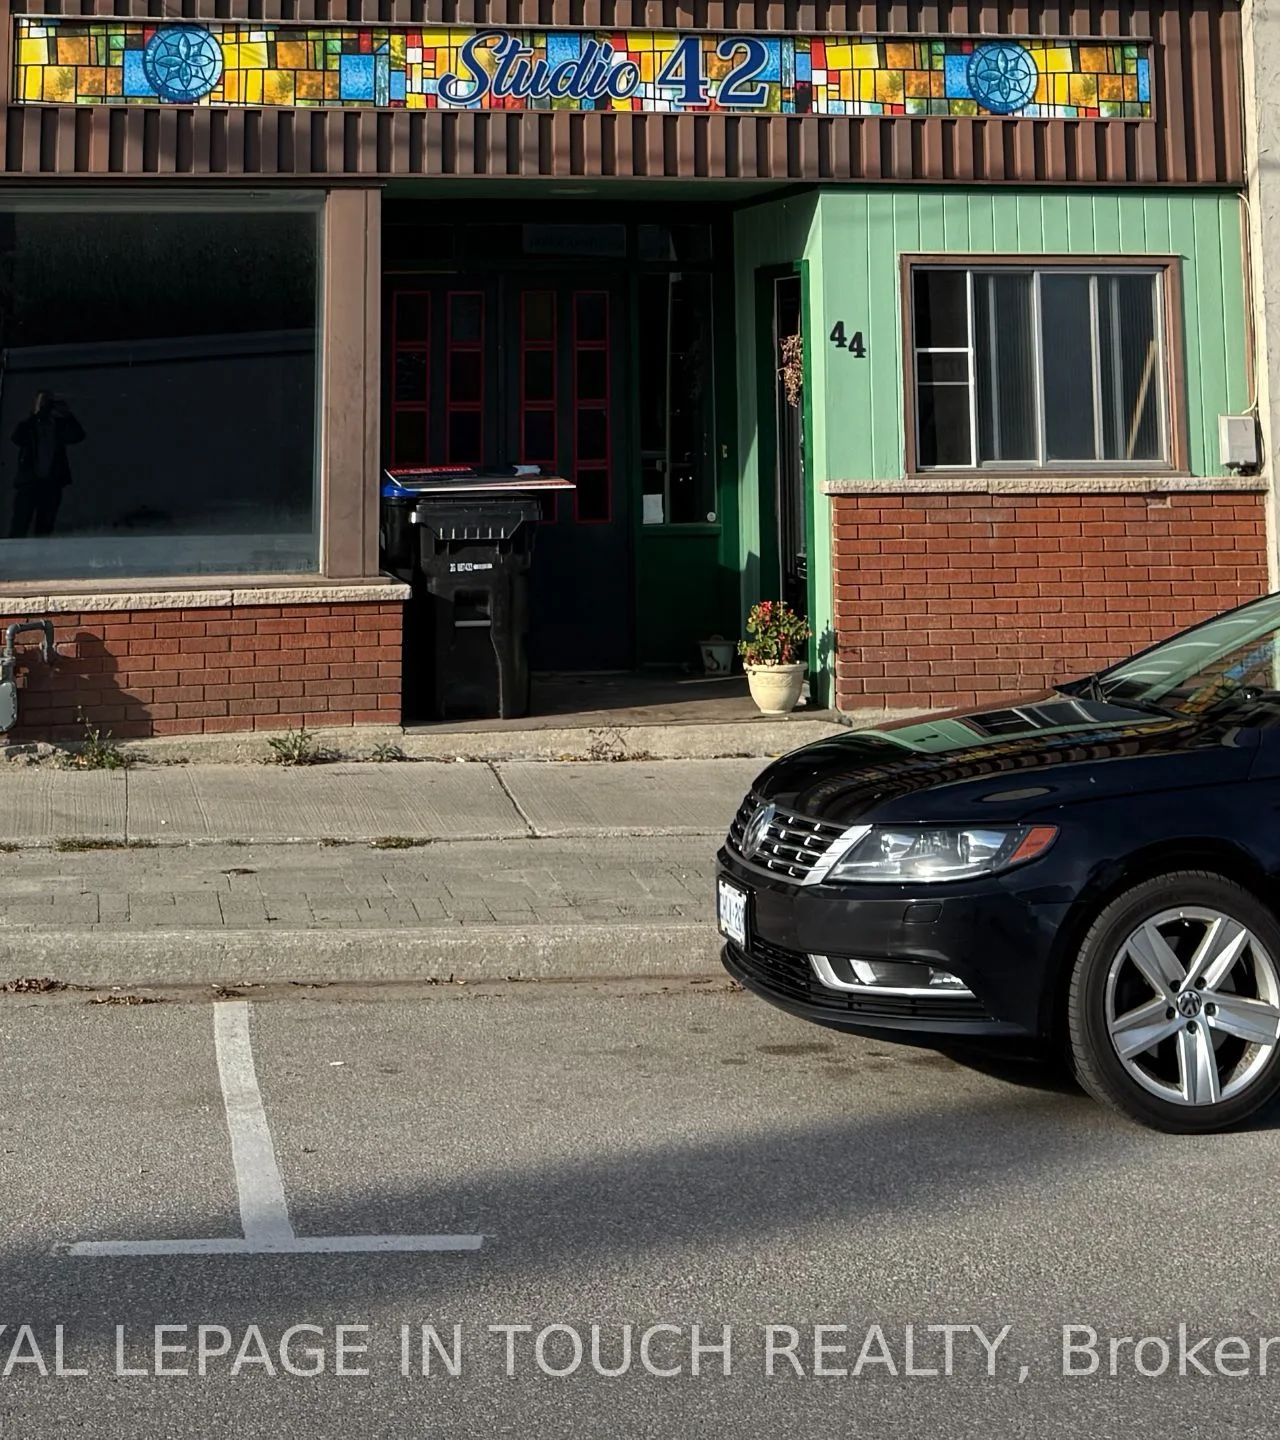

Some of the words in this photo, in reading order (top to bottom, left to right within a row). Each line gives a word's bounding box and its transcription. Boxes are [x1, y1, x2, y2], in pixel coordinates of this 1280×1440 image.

[436, 30, 640, 104] Studio
[654, 35, 769, 108] 42
[830, 320, 867, 358] 44
